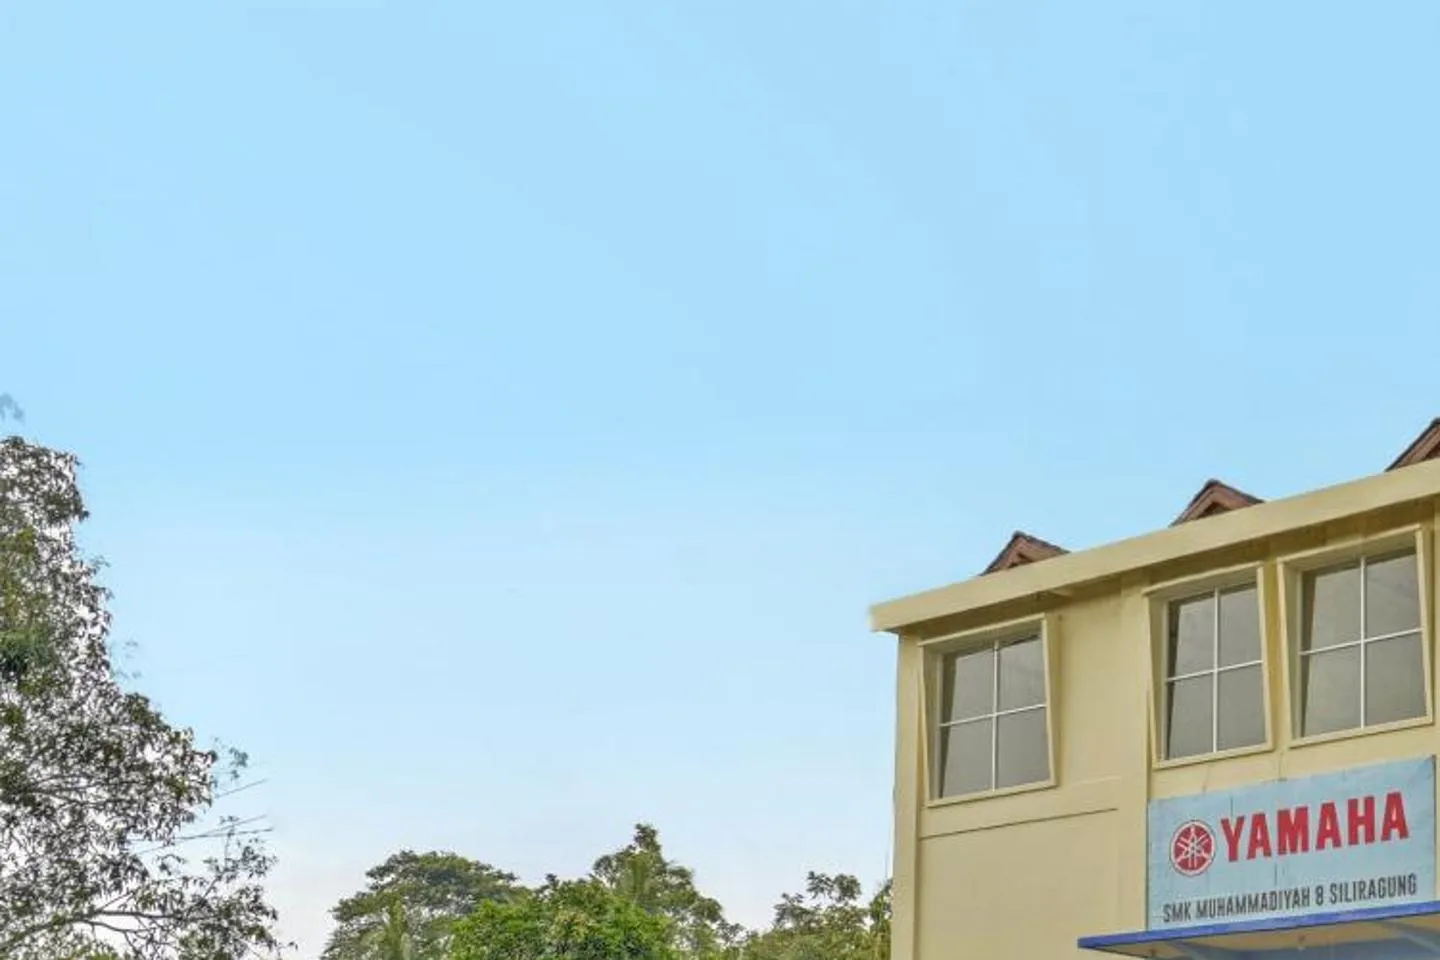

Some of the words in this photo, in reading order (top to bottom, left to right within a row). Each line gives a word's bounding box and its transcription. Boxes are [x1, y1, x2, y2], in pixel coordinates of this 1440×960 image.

[1220, 791, 1409, 862] YAMAHA
[1163, 901, 1191, 922] SMK
[1196, 886, 1311, 919] MUHAMMADIYAH
[1315, 885, 1324, 906] 8
[1329, 873, 1417, 905] SILIRAGUNG
